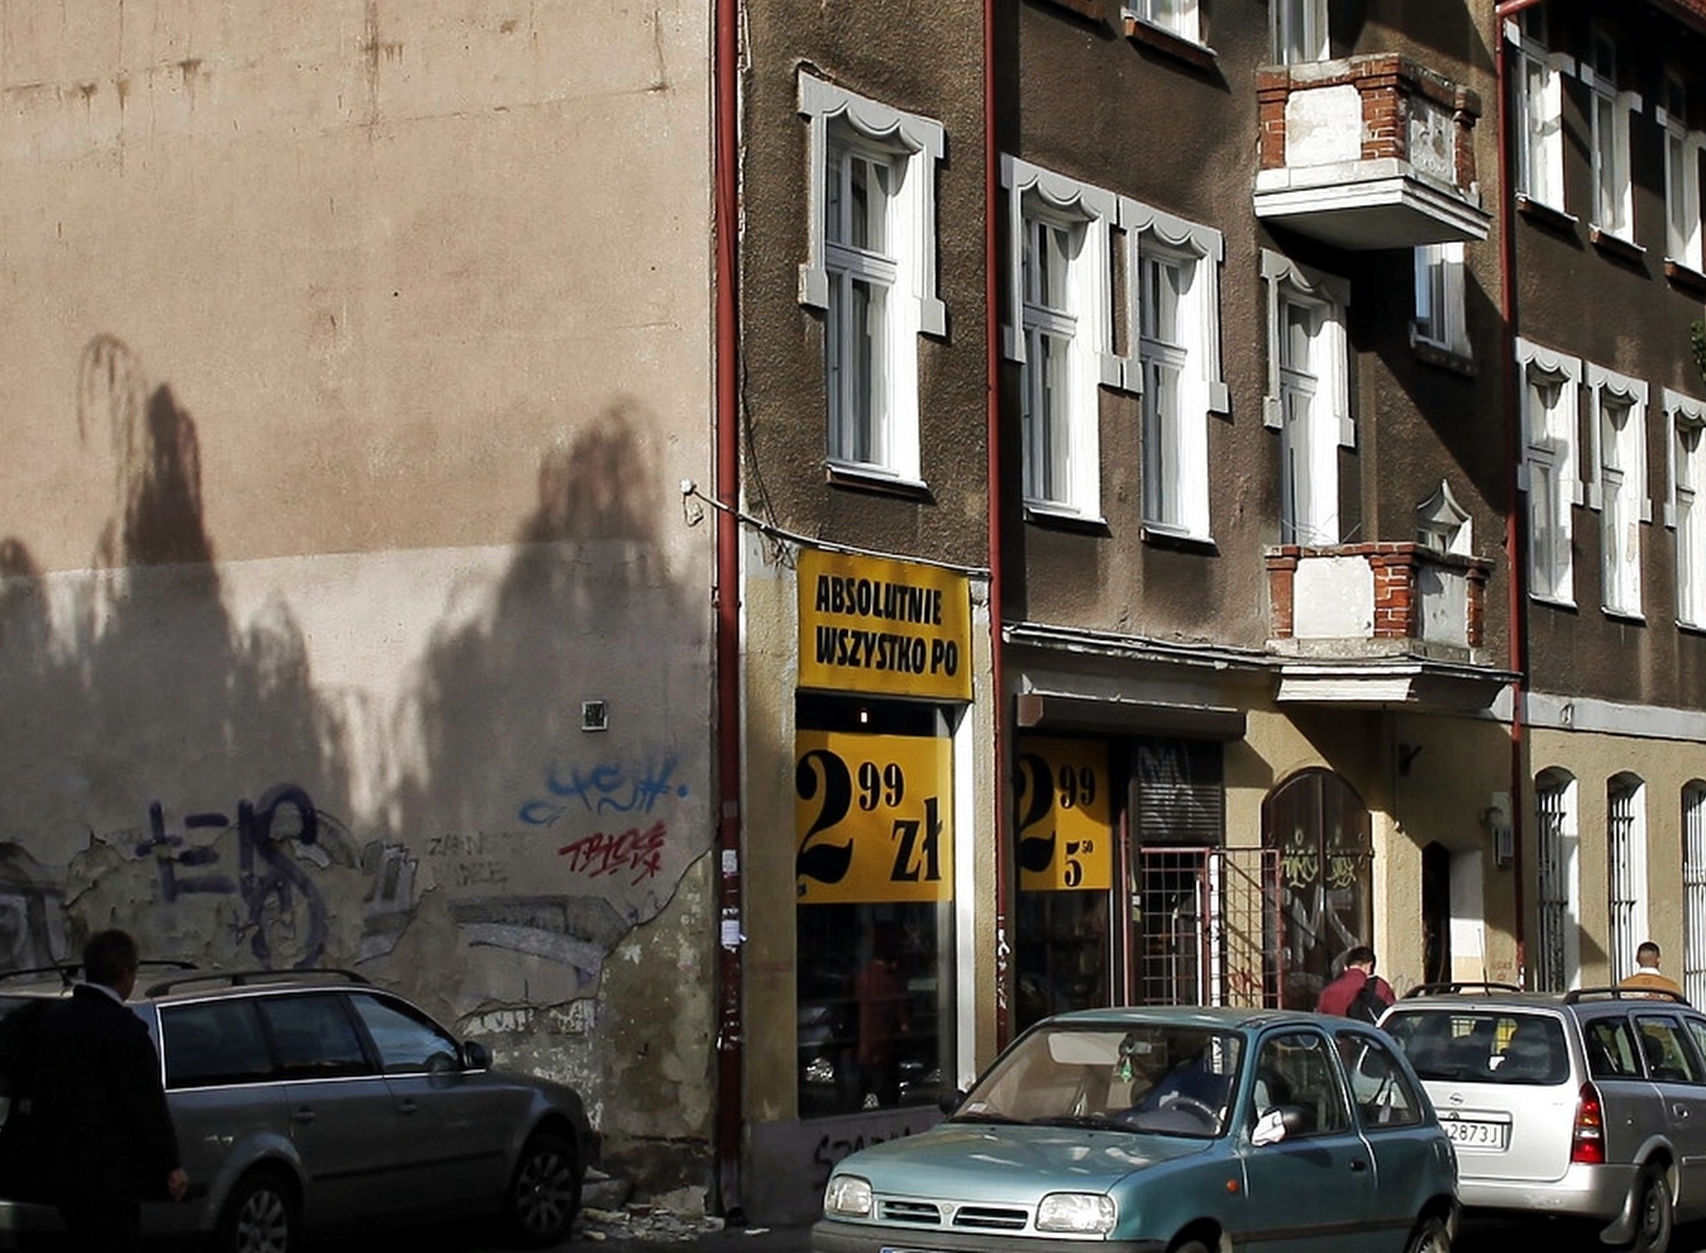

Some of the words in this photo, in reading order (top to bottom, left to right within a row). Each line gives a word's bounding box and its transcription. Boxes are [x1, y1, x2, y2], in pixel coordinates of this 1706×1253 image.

[815, 574, 942, 626] ABSOLUTNIE
[816, 625, 926, 675] WSZYSTKO
[930, 638, 958, 677] PO
[890, 796, 943, 882] zł
